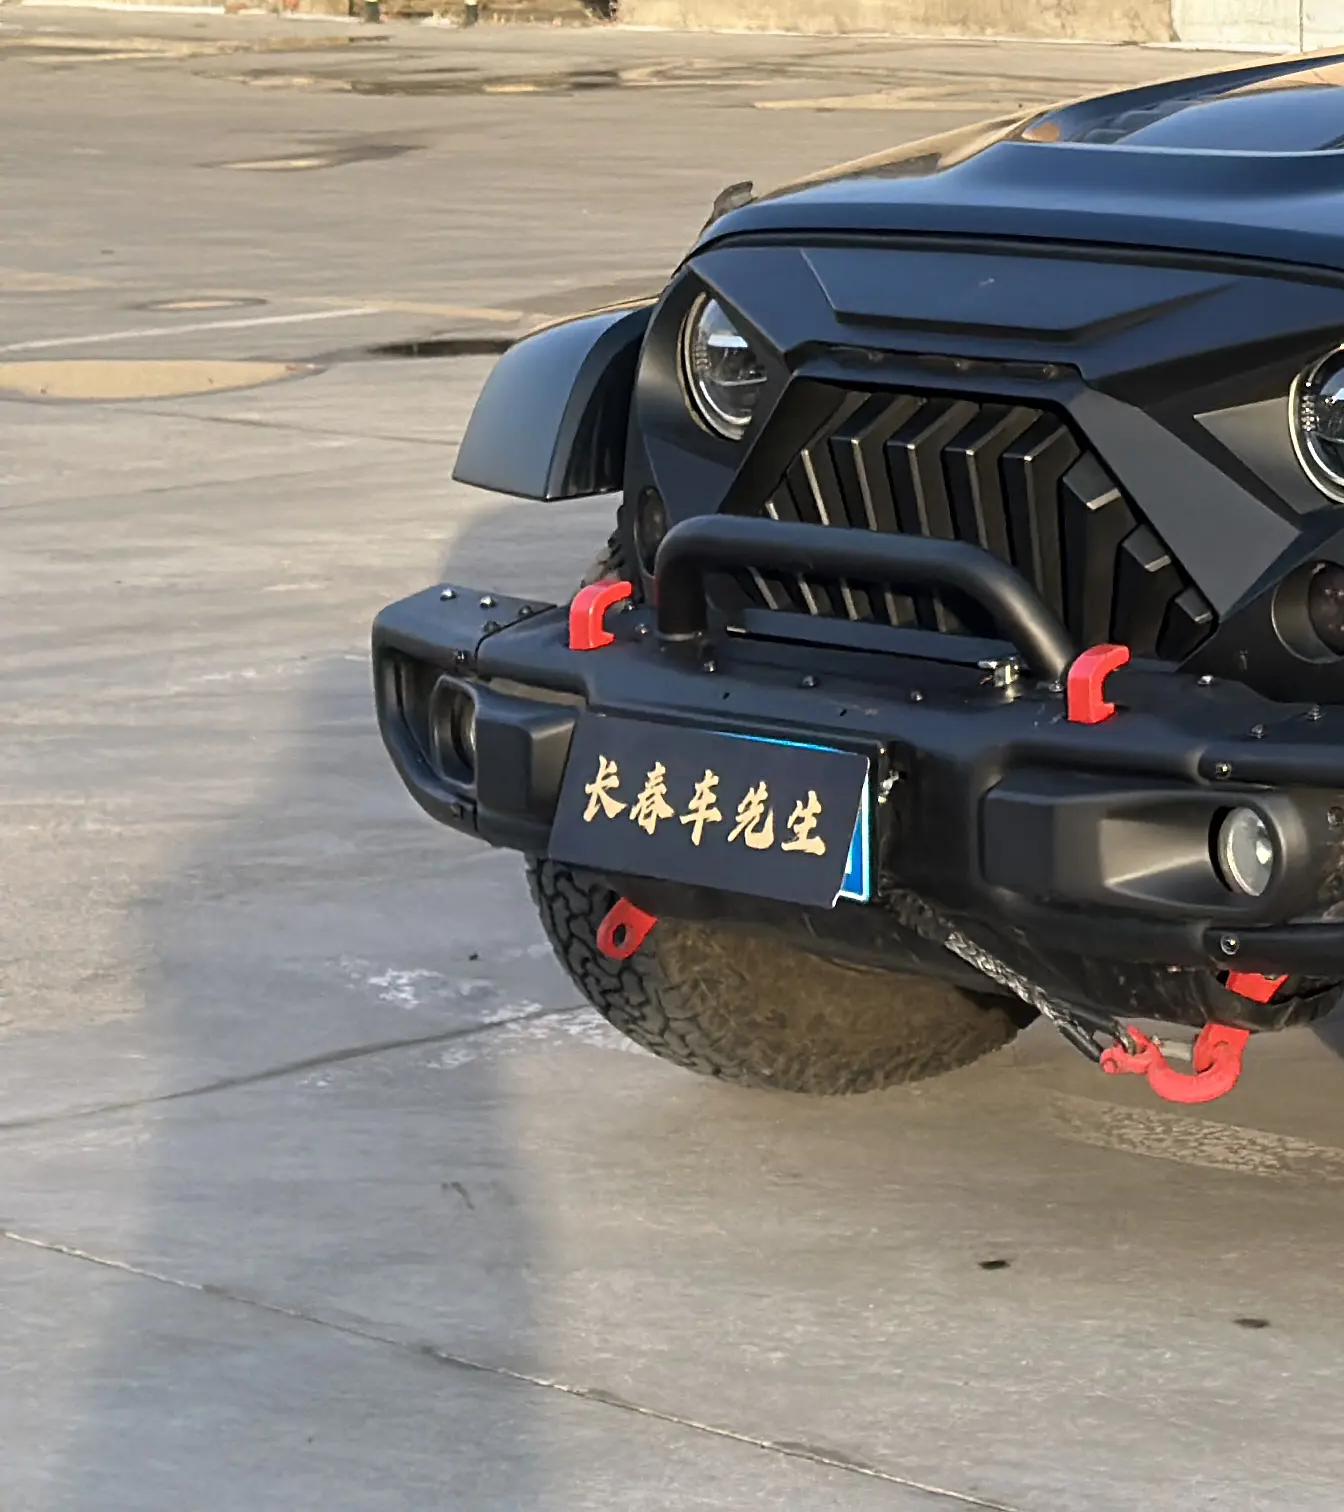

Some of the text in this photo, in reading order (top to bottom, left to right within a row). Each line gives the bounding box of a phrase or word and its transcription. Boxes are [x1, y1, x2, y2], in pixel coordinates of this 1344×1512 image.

[582, 754, 826, 856] 长春车先生
